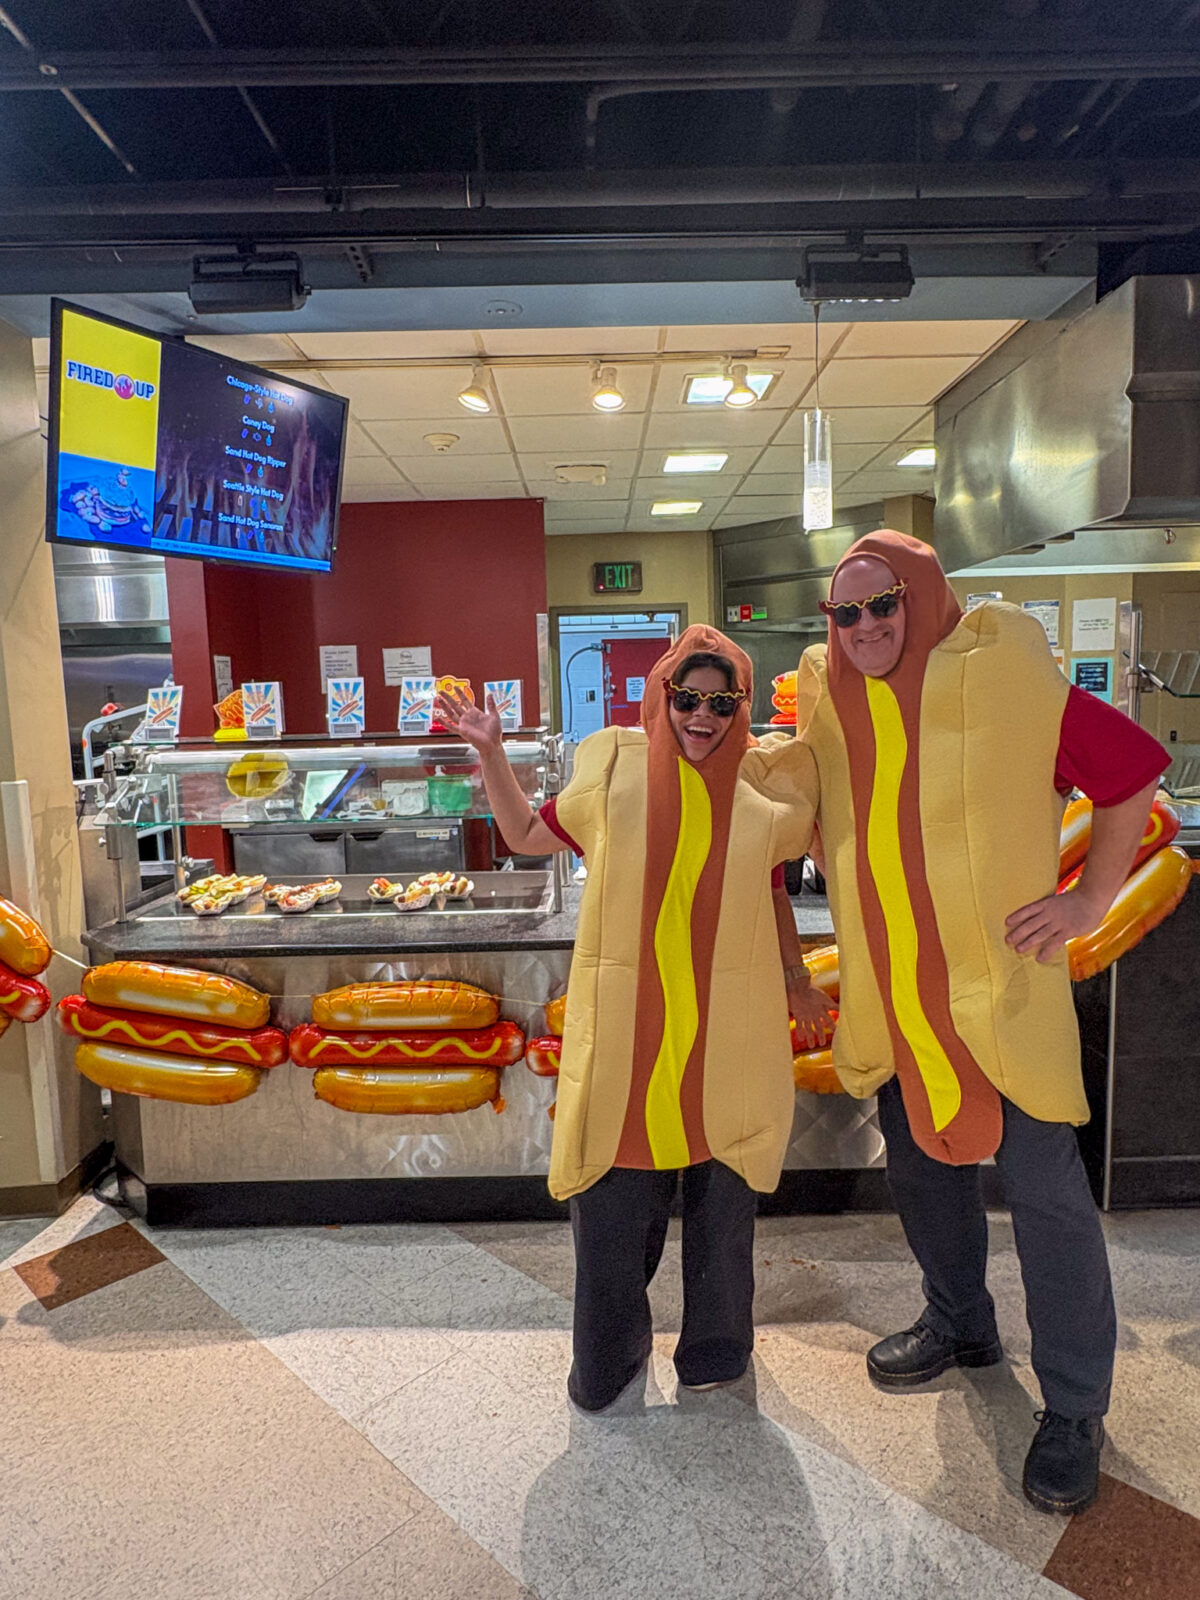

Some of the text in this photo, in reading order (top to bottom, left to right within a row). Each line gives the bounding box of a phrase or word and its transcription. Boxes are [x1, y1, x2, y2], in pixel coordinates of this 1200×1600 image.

[67, 360, 155, 400] FIRED UP
[226, 375, 293, 406] Chicago-Style Hot Dog
[242, 415, 275, 434] Coney Dog
[242, 449, 253, 460] Hot
[254, 452, 266, 465] Dog
[267, 455, 287, 468] Ripper
[223, 479, 284, 501] Seattle Style Hot Dog
[235, 515, 246, 525] Hot
[247, 518, 259, 529] Dog
[604, 565, 633, 589] EXIT
